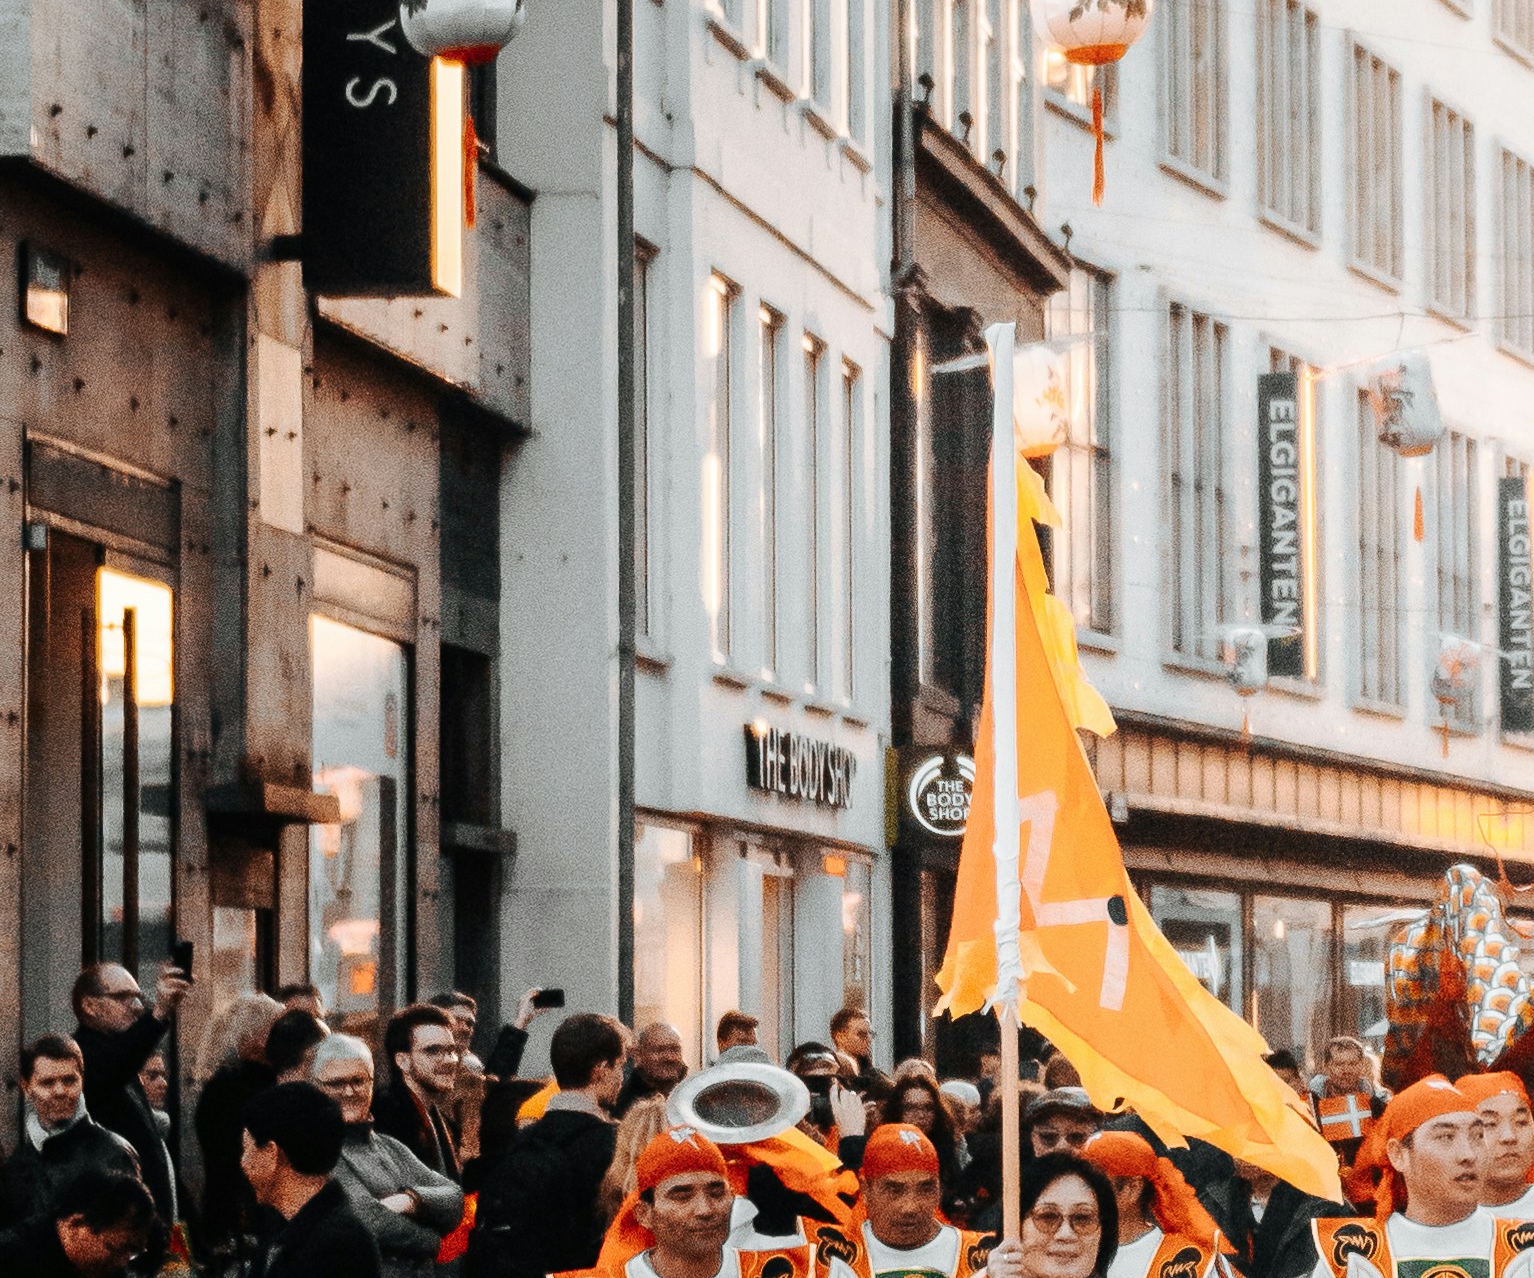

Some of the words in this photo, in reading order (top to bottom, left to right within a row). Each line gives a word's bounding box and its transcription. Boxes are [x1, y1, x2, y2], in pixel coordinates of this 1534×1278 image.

[1269, 399, 1298, 631] ELGIGANTEN
[1508, 500, 1533, 689] ELGIGANTEN
[750, 723, 787, 793] THE
[790, 732, 829, 802] BODY
[937, 780, 963, 793] THE
